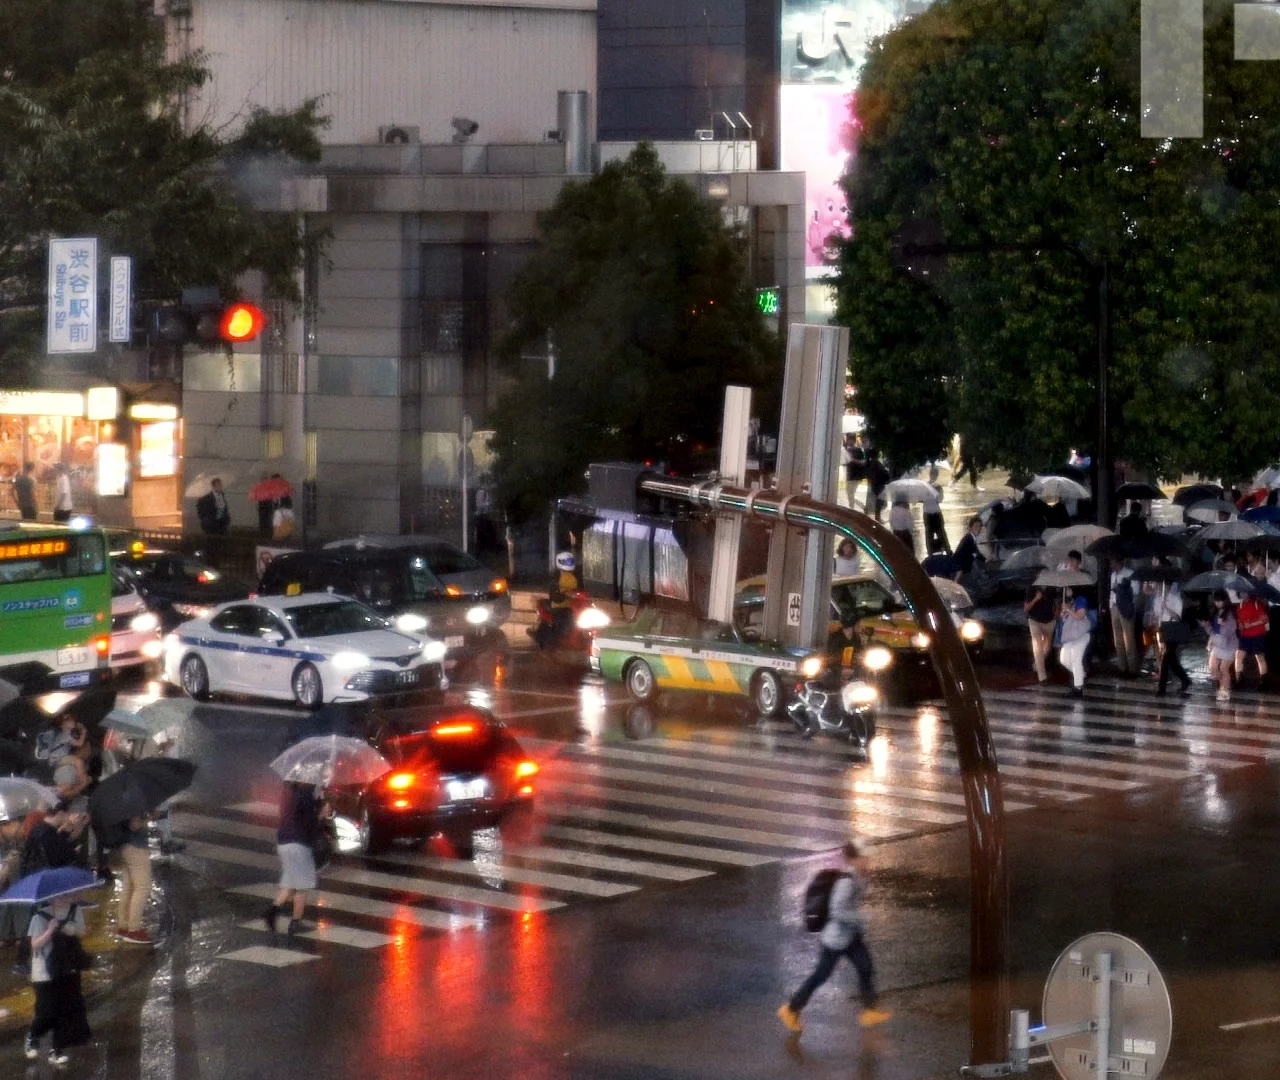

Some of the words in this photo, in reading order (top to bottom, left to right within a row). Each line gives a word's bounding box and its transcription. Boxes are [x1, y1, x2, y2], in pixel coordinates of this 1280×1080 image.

[54, 263, 67, 307] Shibuya
[68, 248, 91, 343] 渋谷駅前
